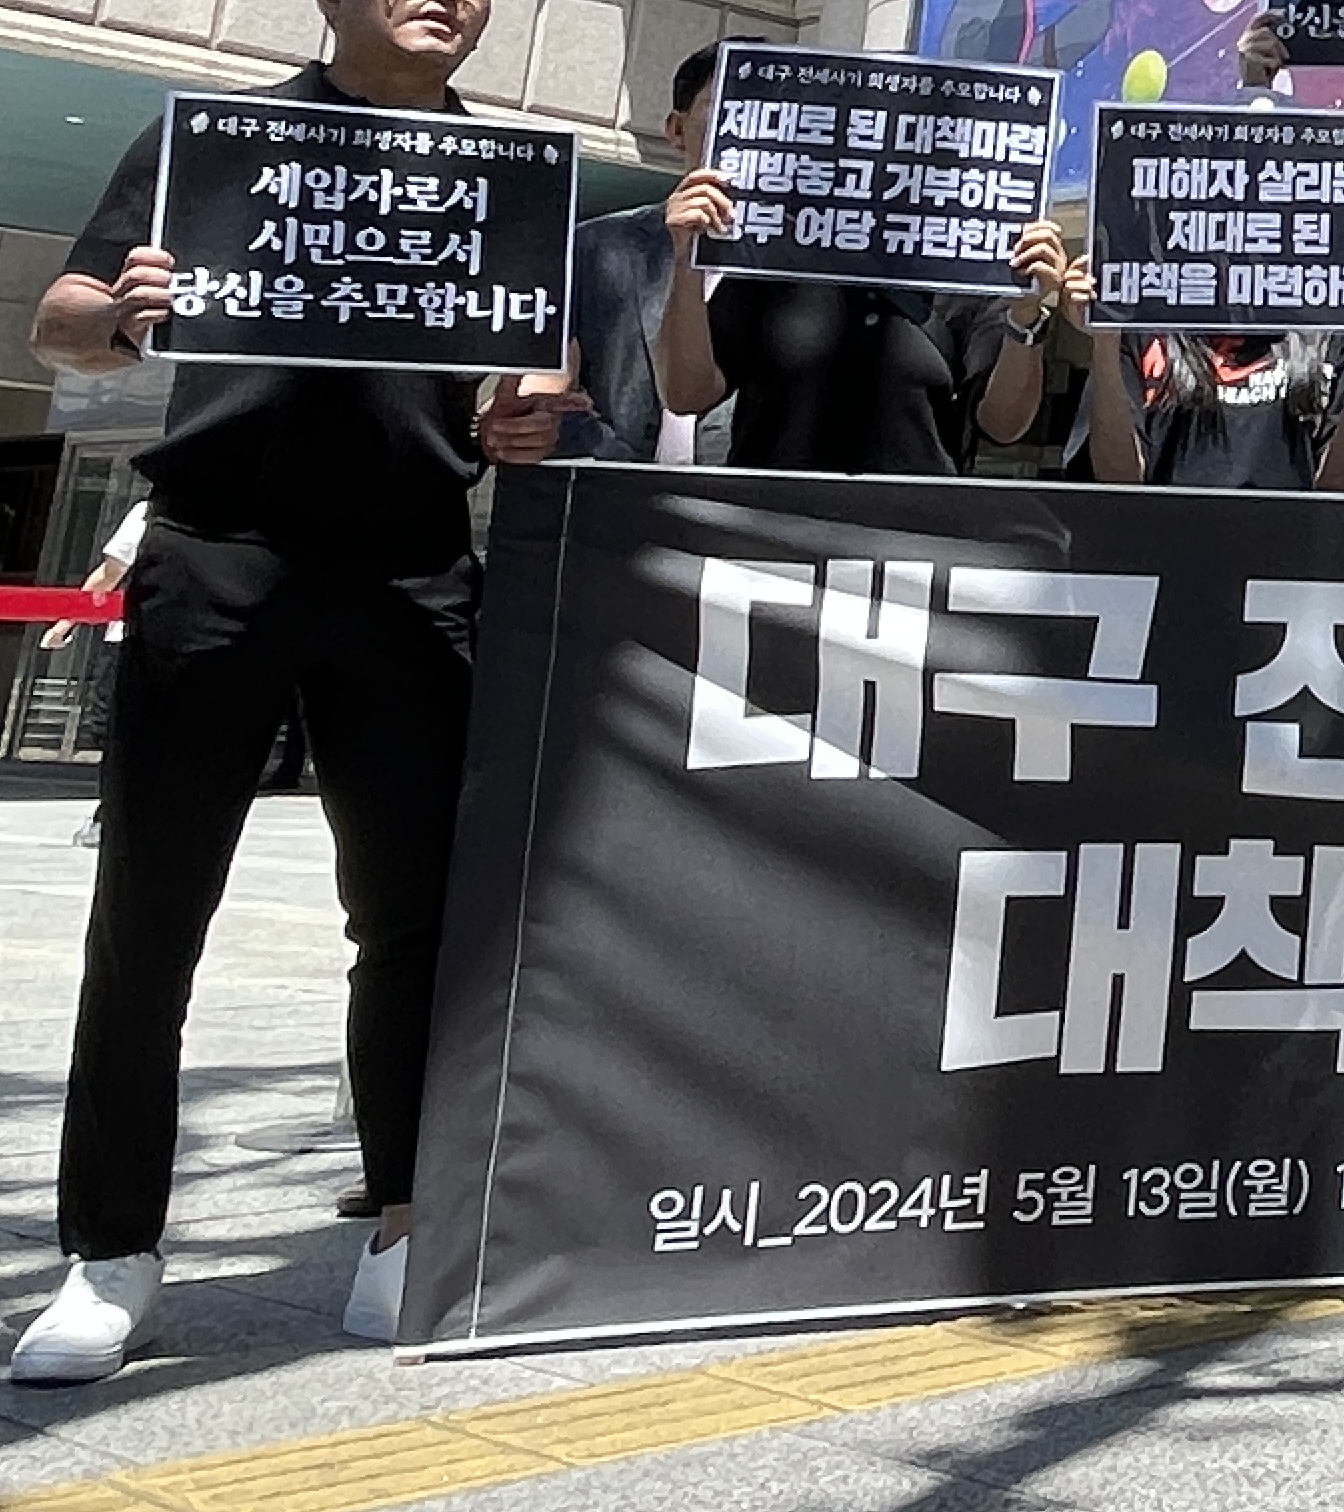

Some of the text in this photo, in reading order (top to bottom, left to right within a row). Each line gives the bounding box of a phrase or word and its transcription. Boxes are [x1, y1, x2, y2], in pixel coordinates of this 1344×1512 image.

[758, 66, 793, 83] 대구
[867, 72, 934, 96] 희생자를
[216, 114, 534, 163] 대구 전세사기 희생자를 추모합니다
[719, 100, 1046, 166] 제대로 된 대책마련
[1130, 122, 1162, 140] 대구
[250, 161, 488, 223] 세입자로서
[882, 162, 1036, 214] 거부하는
[1131, 157, 1249, 201] 피해자
[249, 216, 482, 276] 시민으로서
[794, 206, 878, 251] 여당
[1167, 210, 1331, 255] 제대로 된
[171, 266, 556, 333] 당신을 추모합니다
[1100, 262, 1217, 306] 대책을
[688, 557, 1160, 782] 대구
[648, 1168, 990, 1252] 일시_2024년
[1011, 1164, 1098, 1226] 5월
[1122, 1157, 1312, 1221] 13일(월)
